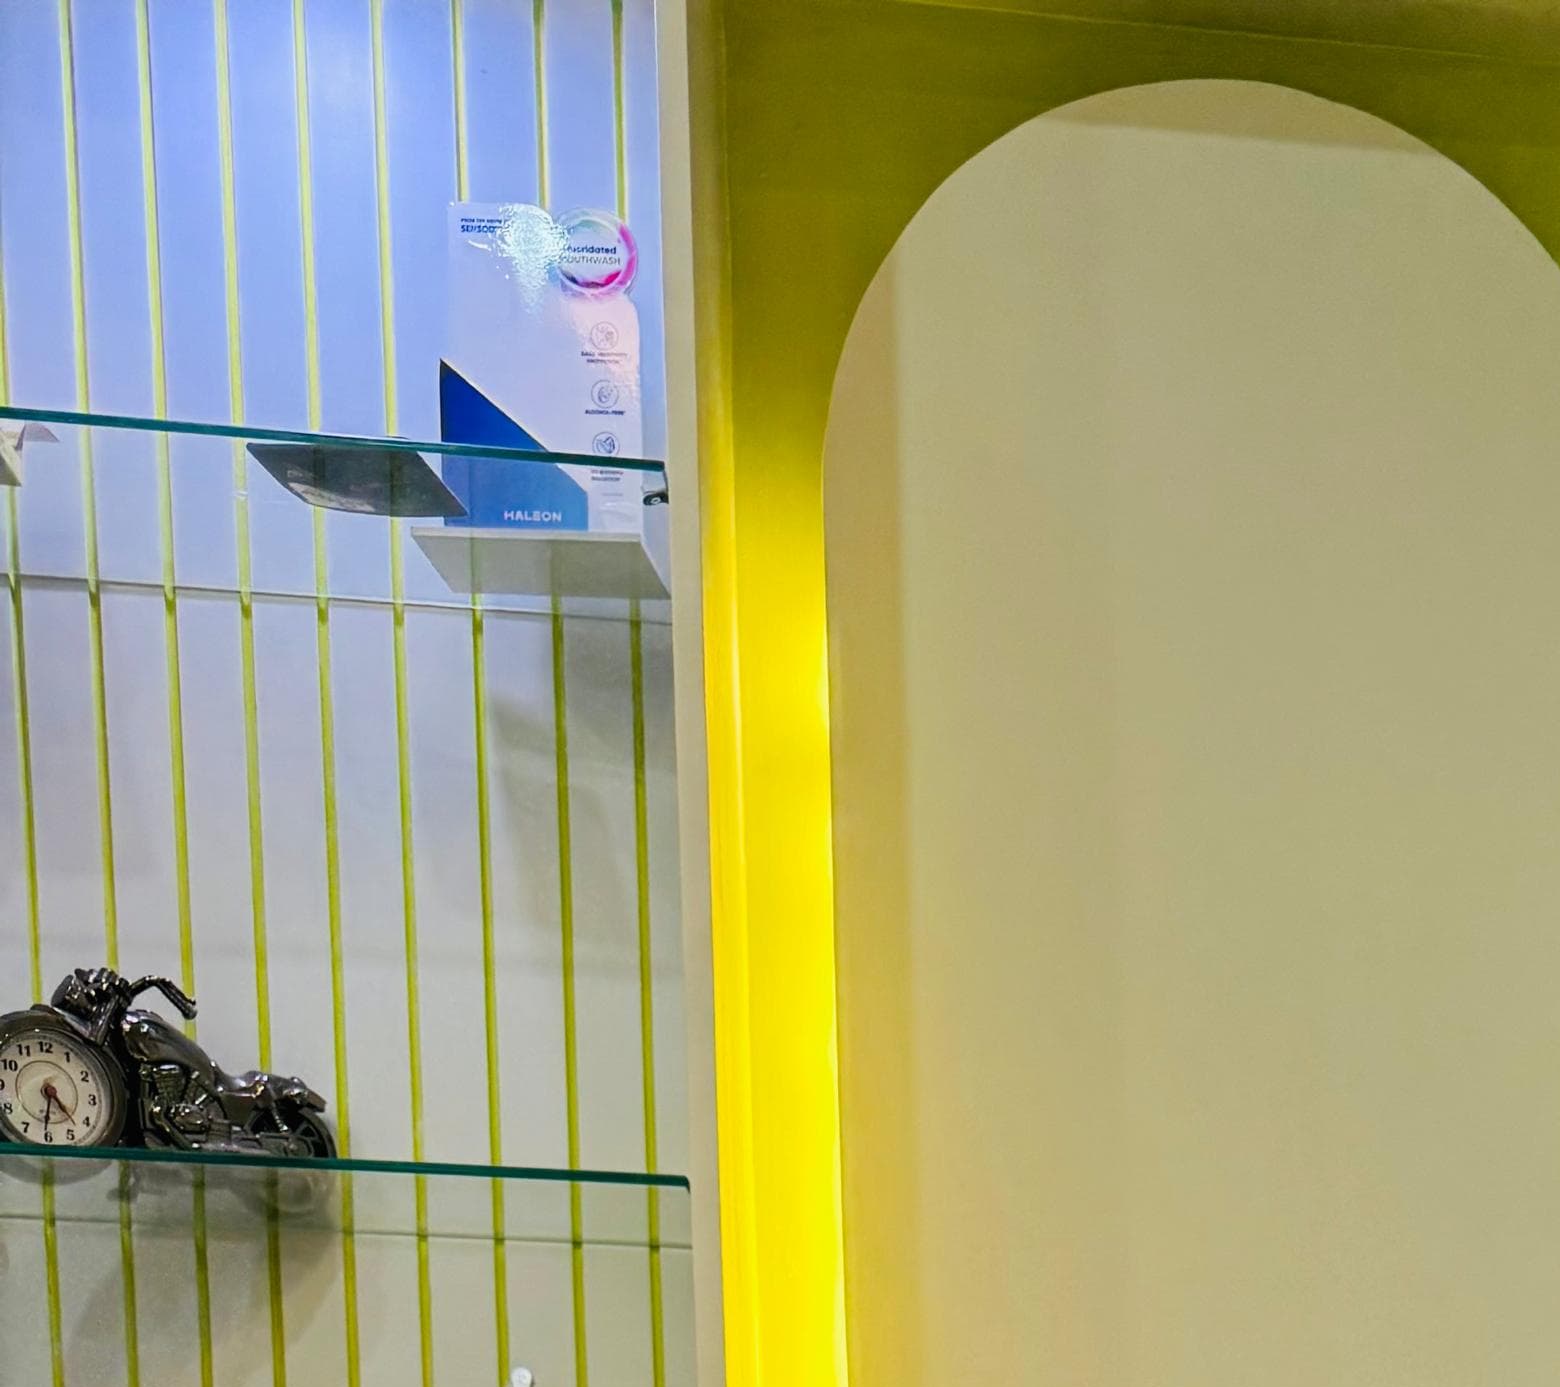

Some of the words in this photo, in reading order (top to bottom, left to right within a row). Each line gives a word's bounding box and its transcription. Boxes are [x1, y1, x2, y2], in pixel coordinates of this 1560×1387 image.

[504, 510, 562, 522] HALEON
[17, 1044, 31, 1057] 11
[39, 1041, 53, 1054] 12
[64, 1051, 71, 1063] 1
[80, 1070, 89, 1083] 2
[88, 1094, 97, 1106] 3
[3, 1102, 13, 1114] 8
[21, 1121, 30, 1133] 7
[82, 1116, 91, 1127] 4
[44, 1131, 53, 1143] 6
[66, 1129, 75, 1141] 5
